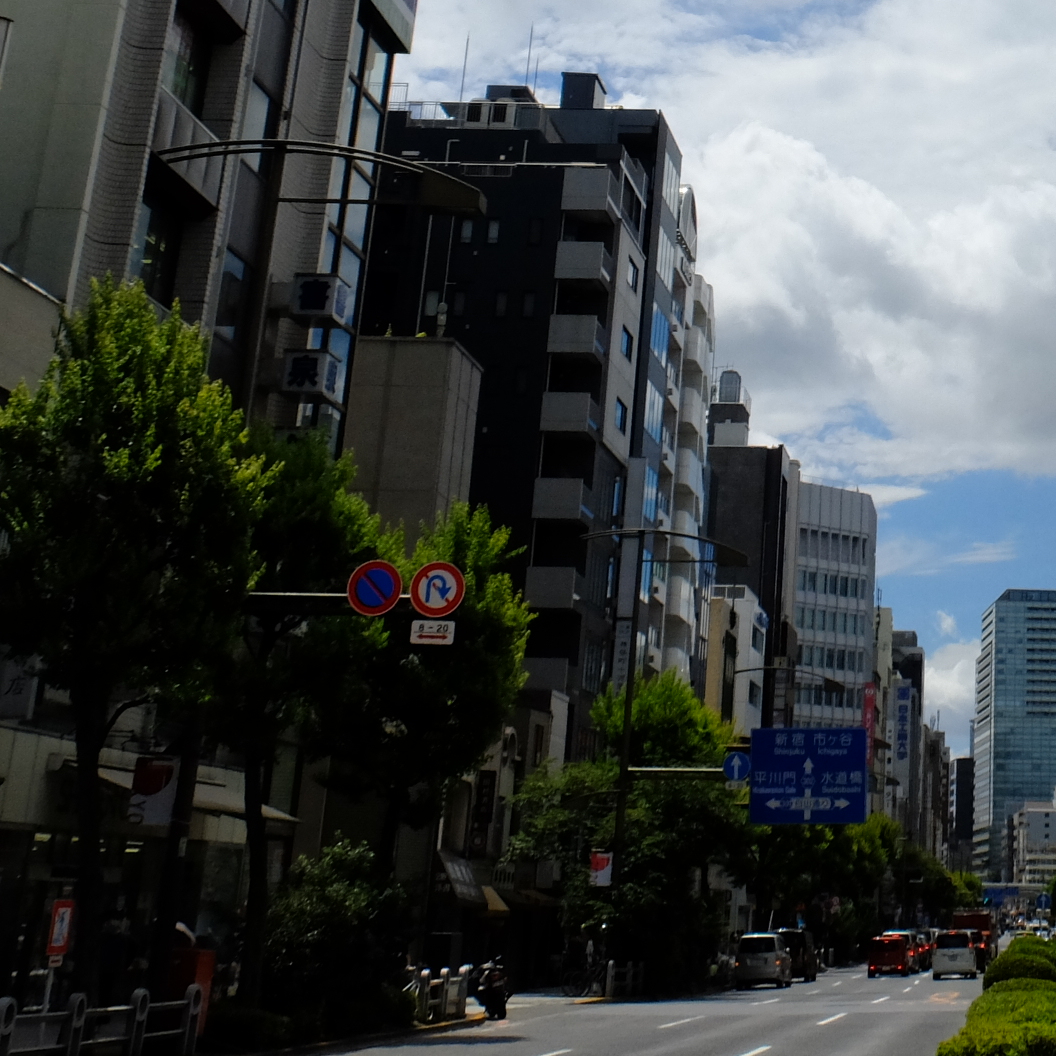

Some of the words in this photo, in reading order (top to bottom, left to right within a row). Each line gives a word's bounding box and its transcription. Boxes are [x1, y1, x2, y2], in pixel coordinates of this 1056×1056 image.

[418, 623, 449, 633] 8-20
[775, 732, 805, 746] 新宿
[754, 771, 796, 785] 平川門
[821, 771, 862, 785] 水道橋
